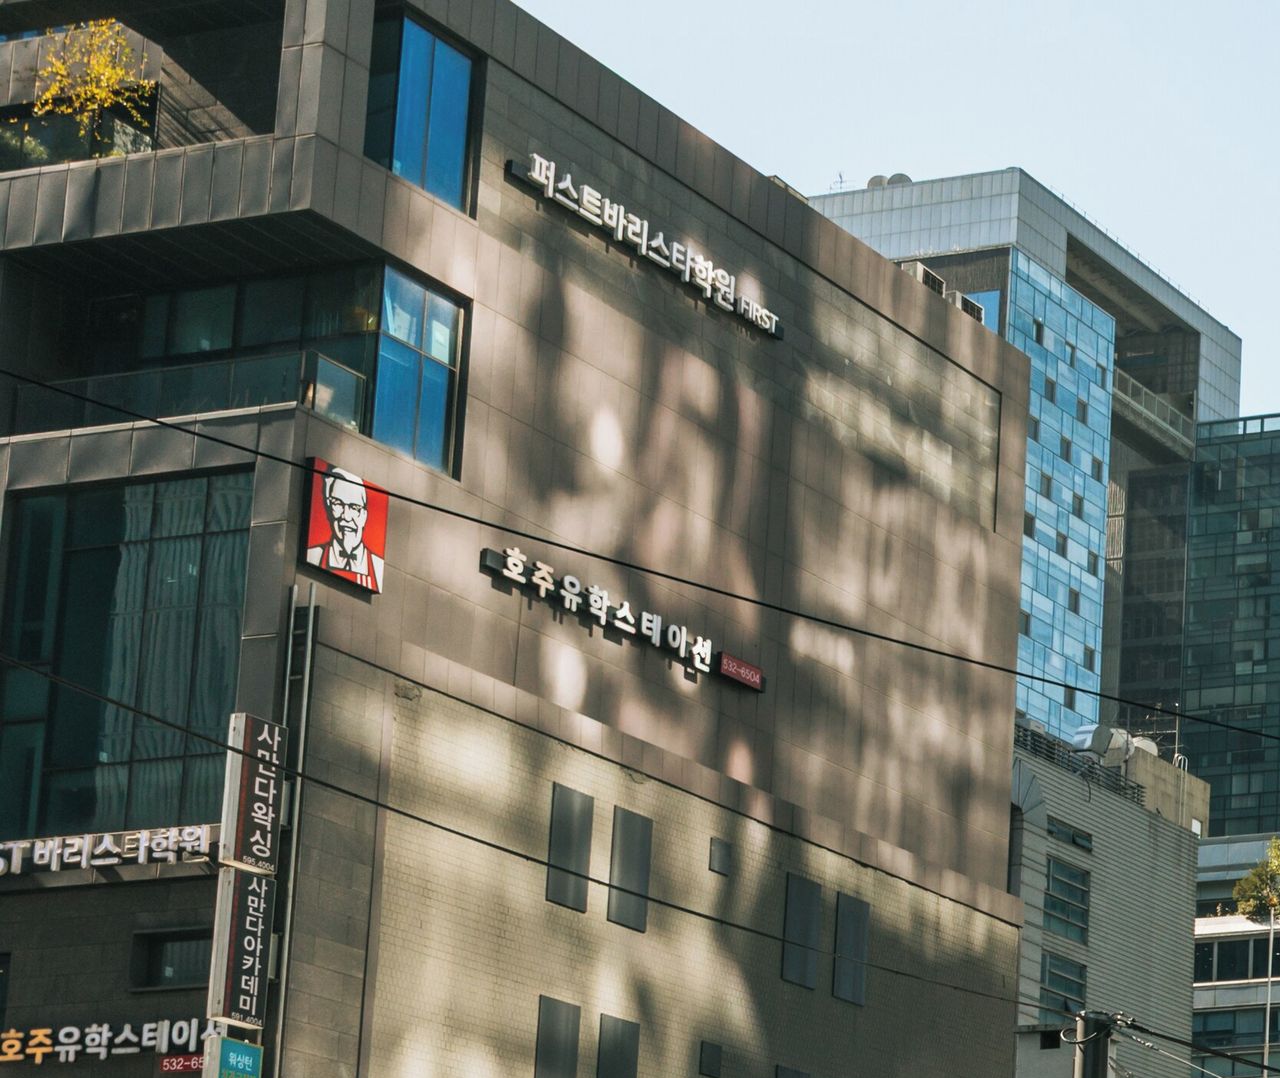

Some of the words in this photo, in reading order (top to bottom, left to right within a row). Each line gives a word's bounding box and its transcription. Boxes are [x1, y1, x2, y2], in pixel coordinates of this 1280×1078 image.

[528, 152, 735, 312] 퍼스트바리스타학원
[737, 295, 780, 334] FIRST
[502, 547, 712, 672] 호주유학스테이션
[722, 659, 760, 684] 532-6504
[33, 824, 211, 872] 바리스타학원
[250, 723, 282, 858] 사만다왁싱
[239, 876, 267, 1016] 사만다아카데미
[229, 1052, 253, 1071] 워싱턴
